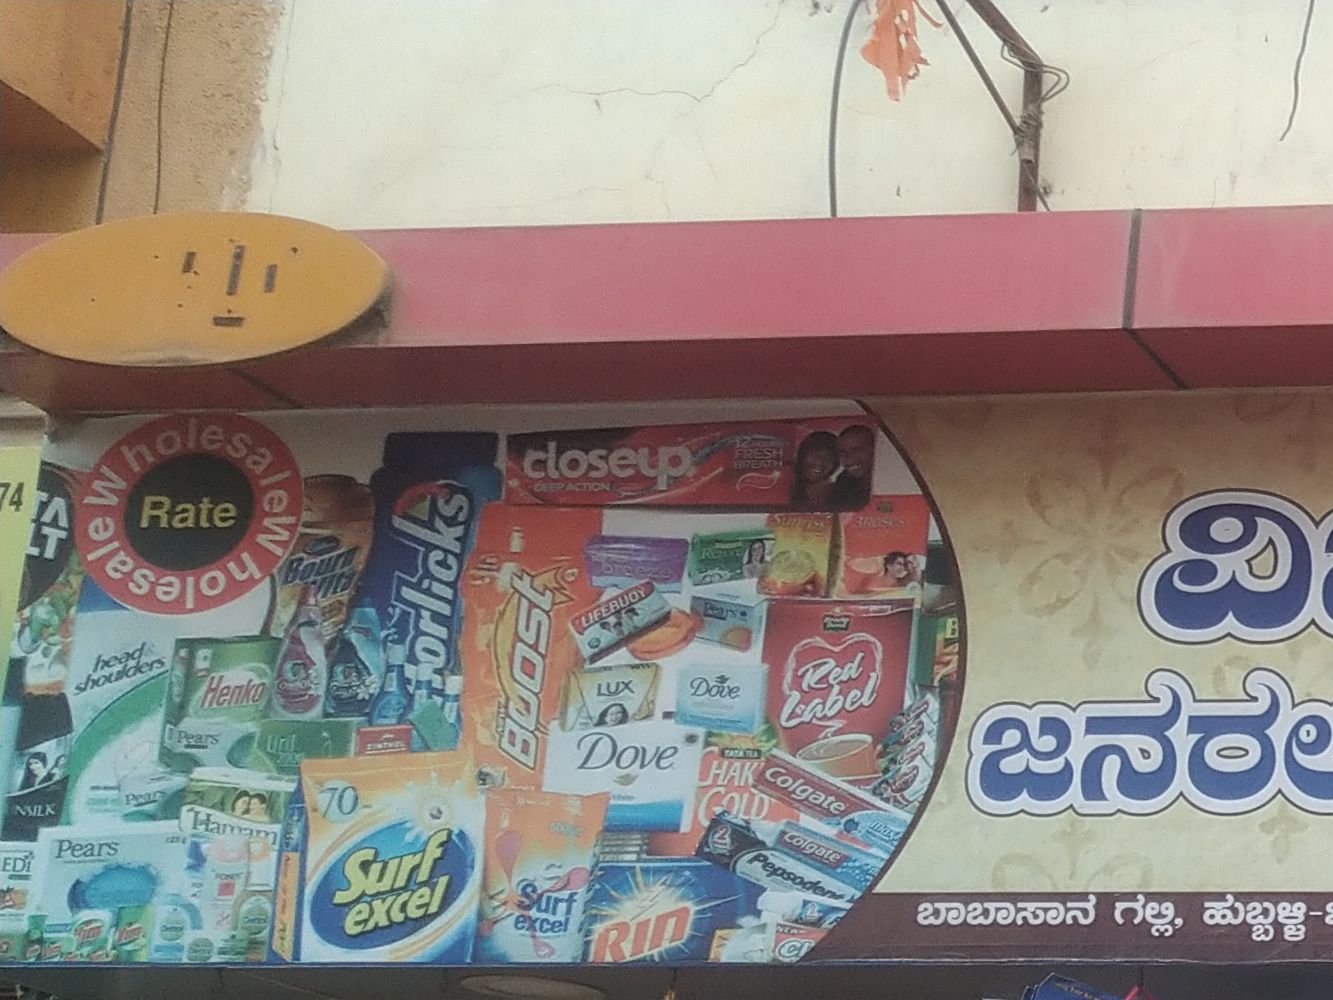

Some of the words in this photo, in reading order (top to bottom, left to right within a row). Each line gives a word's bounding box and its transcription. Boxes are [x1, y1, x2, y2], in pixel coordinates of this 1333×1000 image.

[523, 441, 695, 491] closeup
[140, 494, 238, 529] Rate
[580, 586, 647, 628] LIFEBUOY
[801, 646, 864, 689] Red
[202, 673, 267, 709] Henko
[597, 680, 635, 697] LUX
[690, 677, 741, 699] Dove
[780, 680, 877, 728] Label
[177, 729, 220, 746] Pears
[577, 732, 677, 772] Dove
[765, 764, 850, 815] Colgate
[56, 838, 120, 860] Pears
[784, 830, 842, 863] Colgate
[333, 827, 453, 905] Surf
[344, 873, 447, 937] excel
[518, 878, 576, 919] Surf
[917, 894, 1097, 925] ಬಾಬಾಸಾನ
[514, 912, 569, 935] excel
